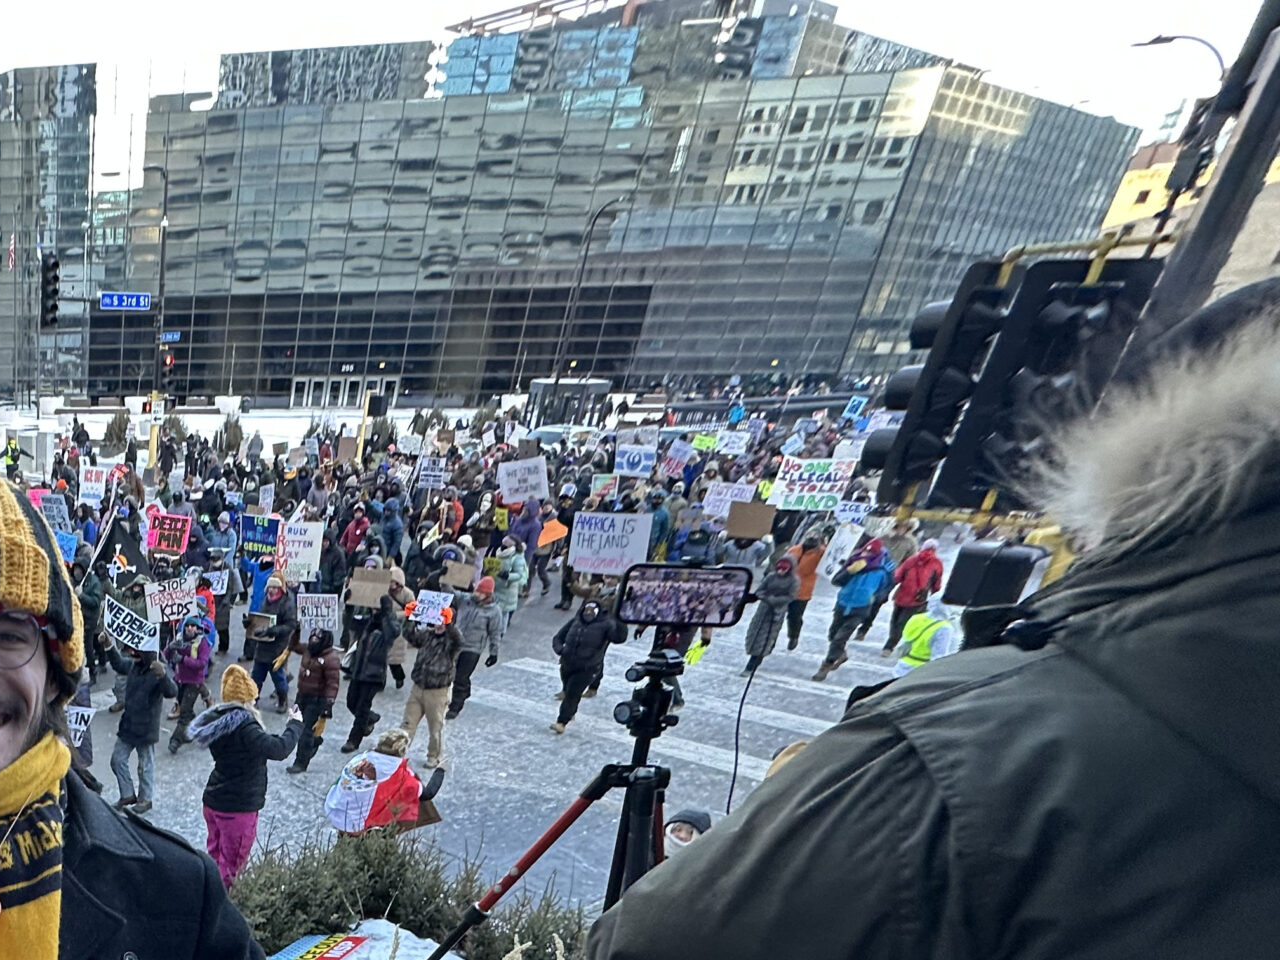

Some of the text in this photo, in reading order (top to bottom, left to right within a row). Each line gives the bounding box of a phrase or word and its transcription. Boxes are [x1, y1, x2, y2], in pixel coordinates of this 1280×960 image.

[122, 295, 137, 306] 3rd
[140, 295, 149, 306] St
[778, 469, 839, 483] ILLEGAL
[782, 494, 839, 509] LAND
[839, 503, 861, 513] ICE
[254, 516, 269, 527] ICE
[574, 513, 638, 534] AMERICA IS
[243, 541, 277, 555] GESTAPO
[157, 577, 187, 592] STOP
[107, 598, 125, 620] WE
[160, 601, 194, 622] KIDS
[300, 605, 331, 618] BUILT
